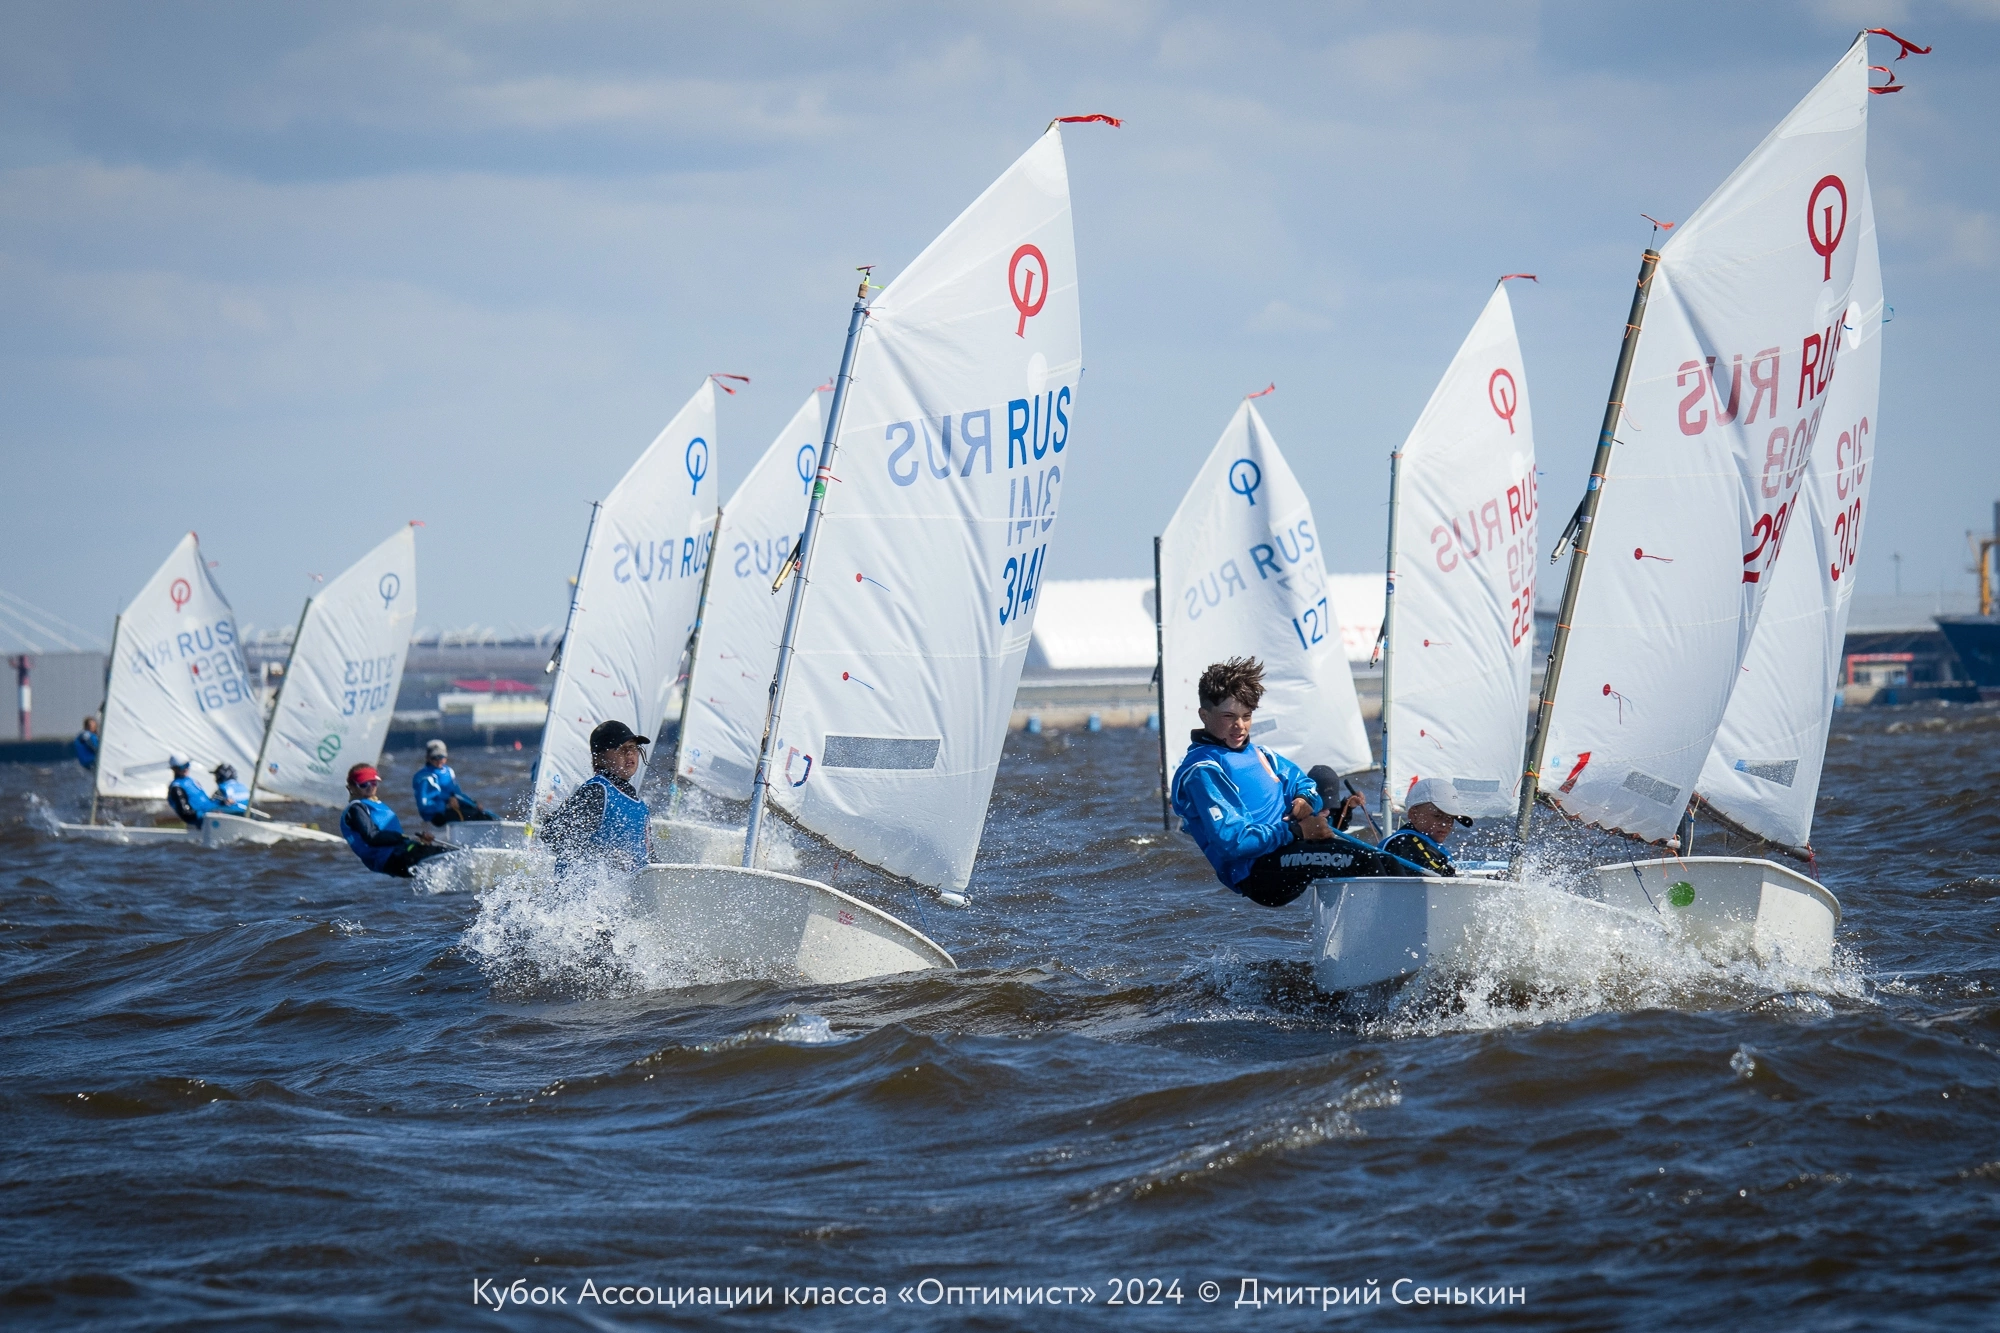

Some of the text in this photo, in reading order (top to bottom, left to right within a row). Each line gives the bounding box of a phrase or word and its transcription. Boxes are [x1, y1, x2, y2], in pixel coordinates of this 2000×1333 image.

[1008, 386, 1071, 469] RUS
[1250, 520, 1315, 580] RUS
[1830, 497, 1861, 582] 313
[999, 543, 1047, 626] 3141
[177, 621, 234, 658] RUS
[1292, 597, 1329, 651] 127
